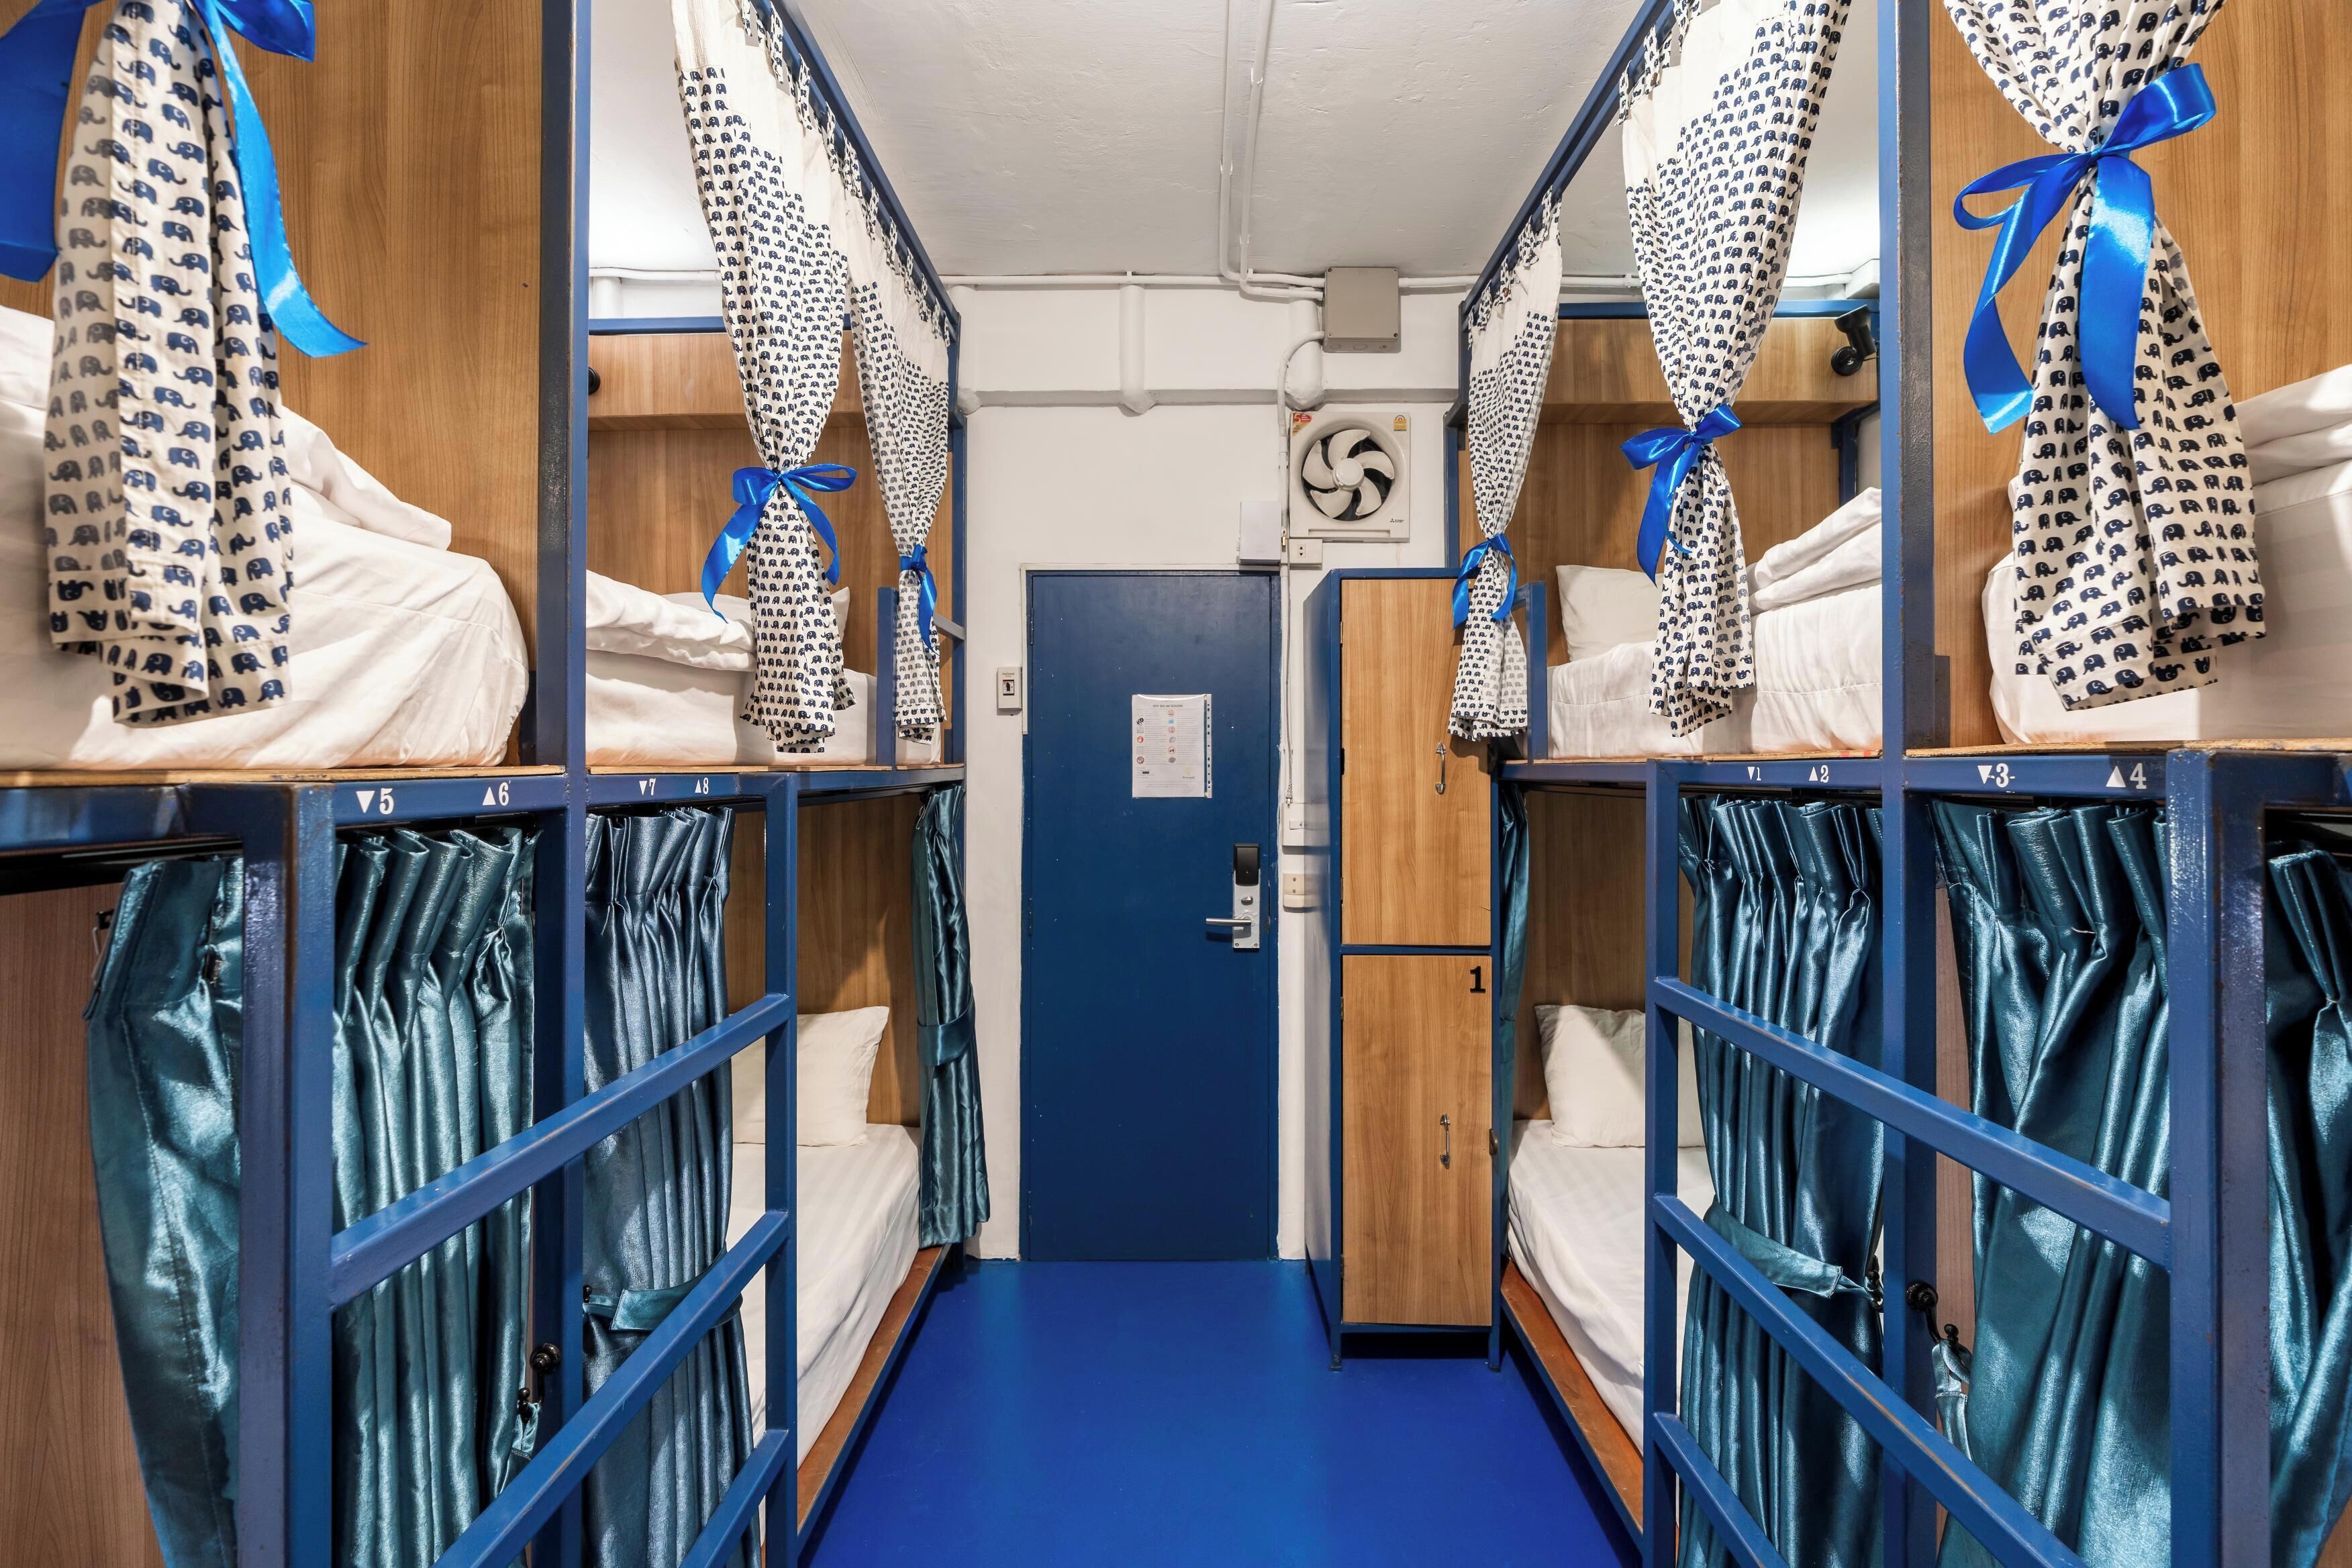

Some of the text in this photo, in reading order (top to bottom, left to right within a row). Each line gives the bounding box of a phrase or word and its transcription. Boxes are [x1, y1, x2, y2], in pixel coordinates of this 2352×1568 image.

[649, 778, 656, 795] 7
[703, 777, 709, 795] 8
[1756, 767, 1761, 781] 1
[1820, 765, 1829, 783] 2
[1996, 763, 2009, 788] 3
[2129, 763, 2147, 789] 4
[379, 787, 395, 815] 5
[498, 781, 509, 806] 6
[1469, 966, 1486, 993] 1
